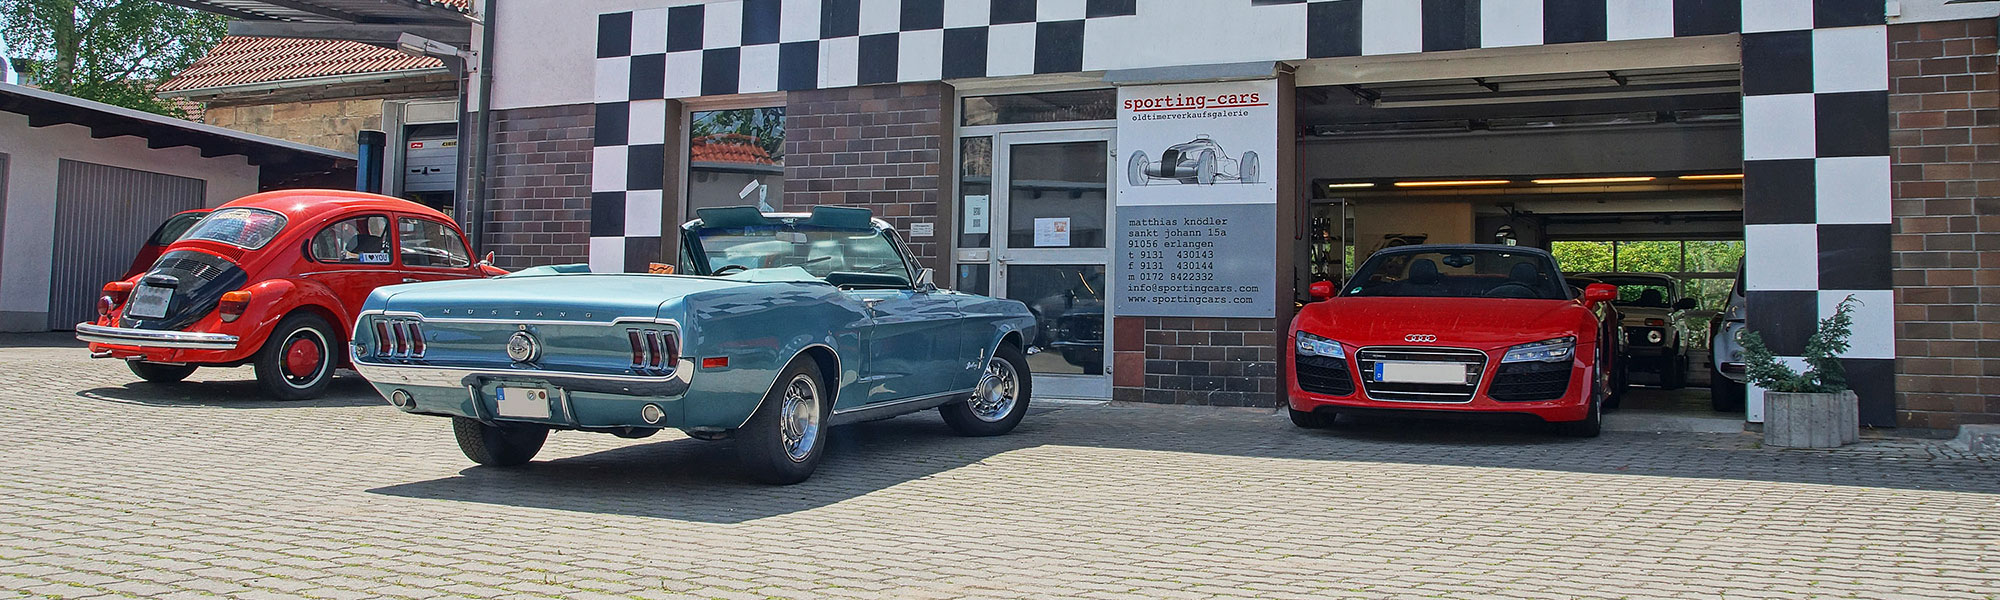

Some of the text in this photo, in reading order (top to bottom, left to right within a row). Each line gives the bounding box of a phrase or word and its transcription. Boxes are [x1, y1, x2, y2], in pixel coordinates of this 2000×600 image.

[1124, 93, 1260, 112] sporting-cars
[1131, 110, 1249, 122] oldtimerverkaufsgalerie
[1128, 217, 1228, 227] matthias knödler
[1128, 228, 1227, 239] sankt johann 15a
[1128, 240, 1214, 250] 91056 erlangen
[1128, 251, 1214, 259] t 9131 430143
[1128, 262, 1214, 270] f 9131 430144
[1140, 273, 1164, 281] 0172
[1170, 273, 1214, 281] 8422332
[1127, 284, 1259, 293] info@sportingcars.com
[1127, 296, 1254, 305] www.sportingcars.com
[442, 308, 593, 318] MUSTANG
